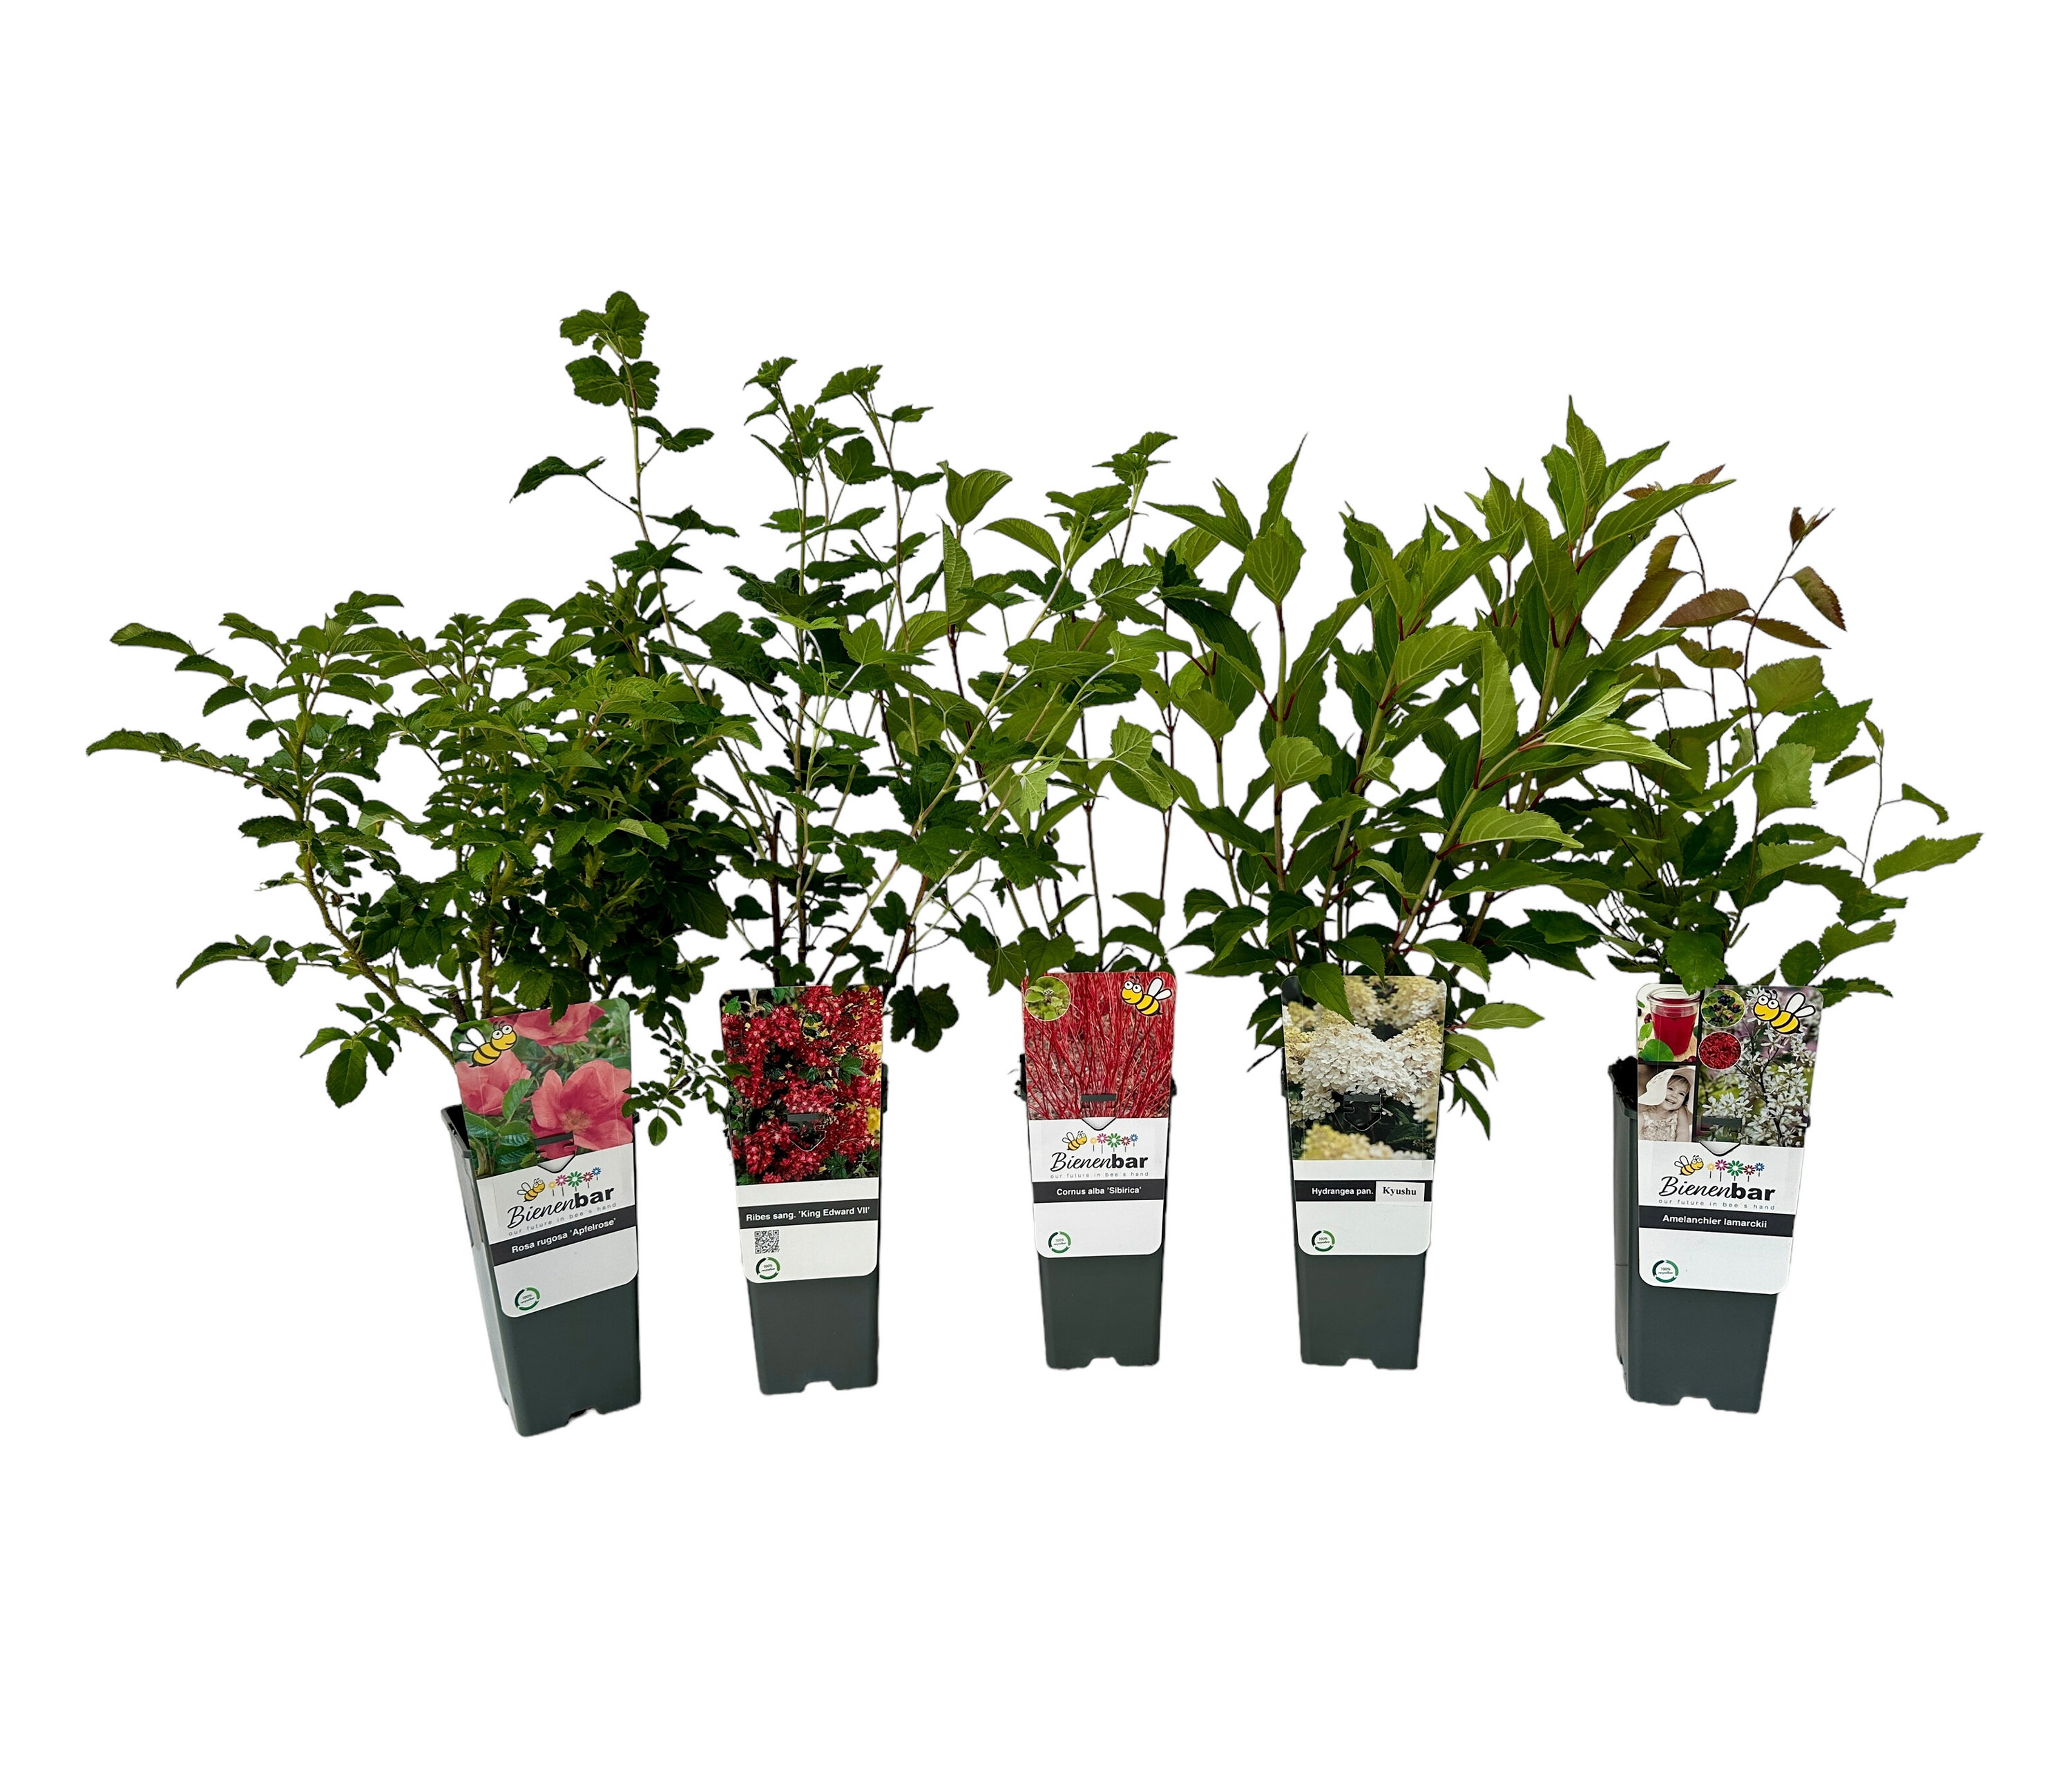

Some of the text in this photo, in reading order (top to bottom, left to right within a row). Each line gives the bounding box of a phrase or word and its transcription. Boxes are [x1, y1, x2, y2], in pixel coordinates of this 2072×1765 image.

[1050, 1152, 1149, 1172] Bienenbar
[1056, 1188, 1086, 1196] Cornus
[1312, 1187, 1354, 1196] Hydrangea
[1383, 1186, 1417, 1197] Kyushu
[1658, 1176, 1776, 1201] Bienenbar
[507, 1187, 615, 1229] Bienenbar
[526, 1220, 553, 1231] future
[597, 1202, 617, 1212] hand
[746, 1212, 771, 1222] Ribes
[773, 1213, 796, 1222] sang.
[823, 1207, 854, 1217] Edward
[1662, 1214, 1767, 1228] Amelanchier lamarckii
[511, 1241, 535, 1253] Rosa
[537, 1232, 568, 1246] rugosa
